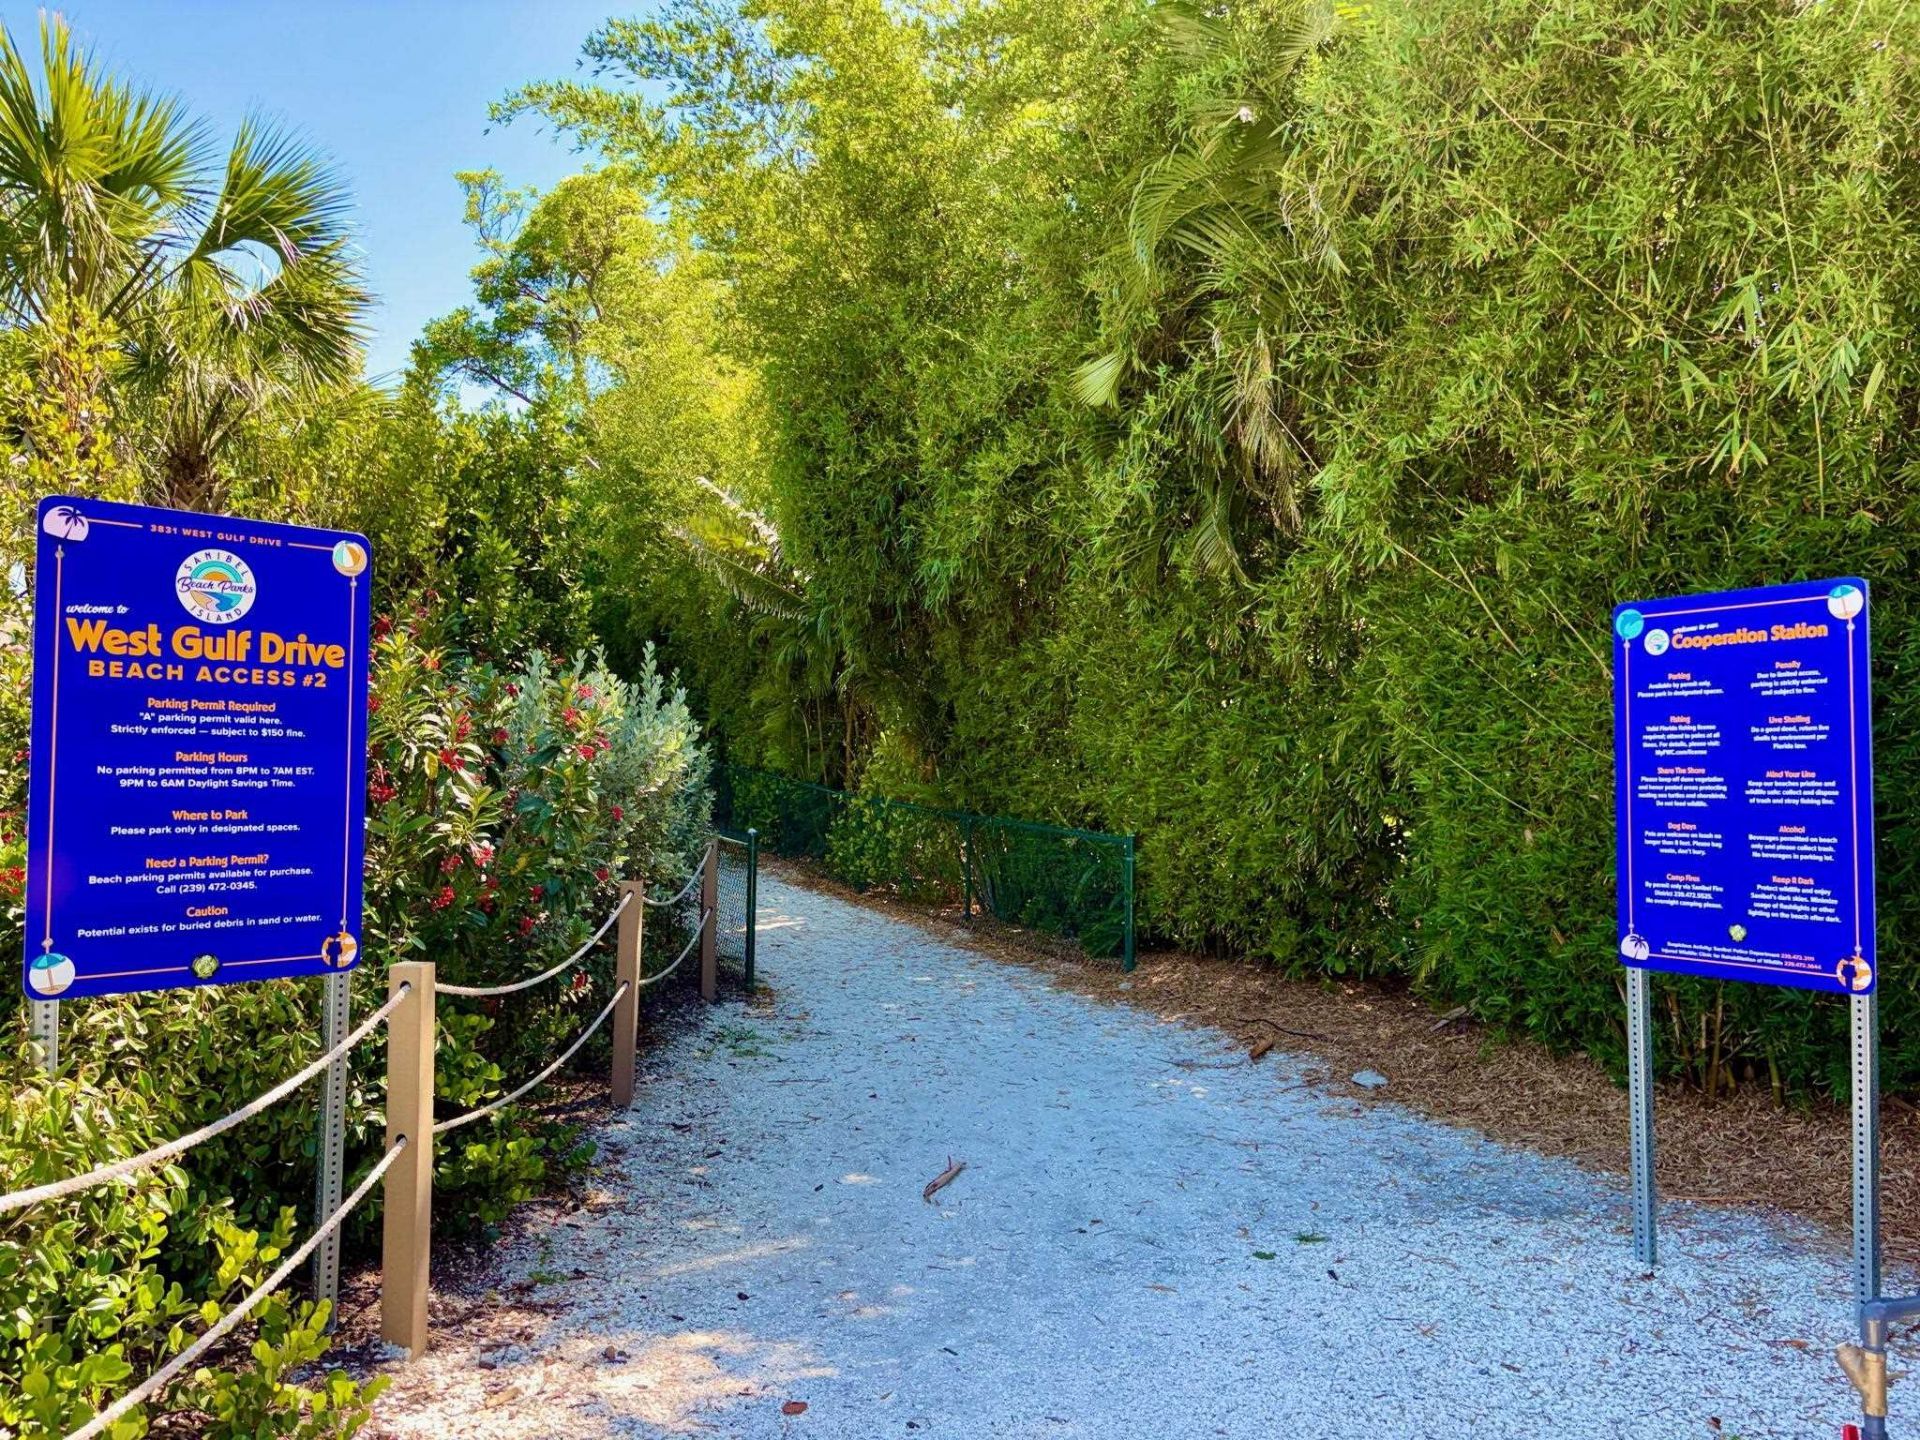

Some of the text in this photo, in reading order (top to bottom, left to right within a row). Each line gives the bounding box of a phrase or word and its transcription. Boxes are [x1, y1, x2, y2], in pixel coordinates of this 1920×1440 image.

[151, 524, 281, 547] 3831 WEST GULF DRIVE
[184, 552, 249, 577] SANIBEL
[177, 576, 253, 594] Beach Parks
[66, 604, 128, 614] welcome to
[190, 605, 242, 622] ISLAND
[66, 618, 345, 668] West Gulf Drive
[1671, 628, 1768, 649] Cooperation
[1771, 623, 1829, 641] Station
[88, 660, 326, 688] BEACH ACCESS #2
[1668, 672, 1691, 681] Parking
[147, 697, 276, 714] Parking Permit Required
[140, 712, 155, 721] "A"
[158, 714, 197, 724] parking
[199, 715, 231, 724] permit
[234, 716, 257, 724] valid
[111, 724, 148, 736] Strictly
[151, 726, 196, 735] enforced
[211, 728, 246, 737] subject
[261, 728, 284, 737] $150
[286, 729, 306, 737] fine.
[175, 751, 248, 765] Parking Hours
[97, 766, 113, 774] No
[116, 766, 156, 776] parking
[158, 766, 208, 775] permitted
[211, 767, 234, 775] from
[236, 767, 258, 775] 8PM
[273, 767, 293, 775] 7AM
[296, 767, 314, 775] EST.
[120, 779, 144, 787] 9PM
[161, 779, 185, 787] 6AM
[188, 779, 229, 789] Daylight
[231, 779, 268, 789] Savings
[271, 779, 295, 787] Time.
[172, 809, 248, 821] Where to Park
[111, 826, 146, 835] Please
[149, 826, 172, 836] park
[174, 825, 196, 835] only
[199, 825, 209, 833] in
[211, 824, 264, 834] designated
[1779, 825, 1806, 834] Alcohol
[145, 854, 269, 869] Need a Parking Permit?
[88, 875, 122, 885] Beach
[125, 873, 165, 884] parking
[168, 871, 206, 882] permits
[209, 870, 251, 879] available
[269, 868, 313, 877] purchase.
[156, 881, 256, 894] Call (239) 472-0345.
[186, 906, 229, 917] Caution
[77, 927, 125, 938] Potential
[128, 925, 159, 934] exists
[162, 924, 176, 932] for
[179, 921, 211, 931] buried
[214, 919, 244, 928] debris
[258, 917, 281, 925] sand
